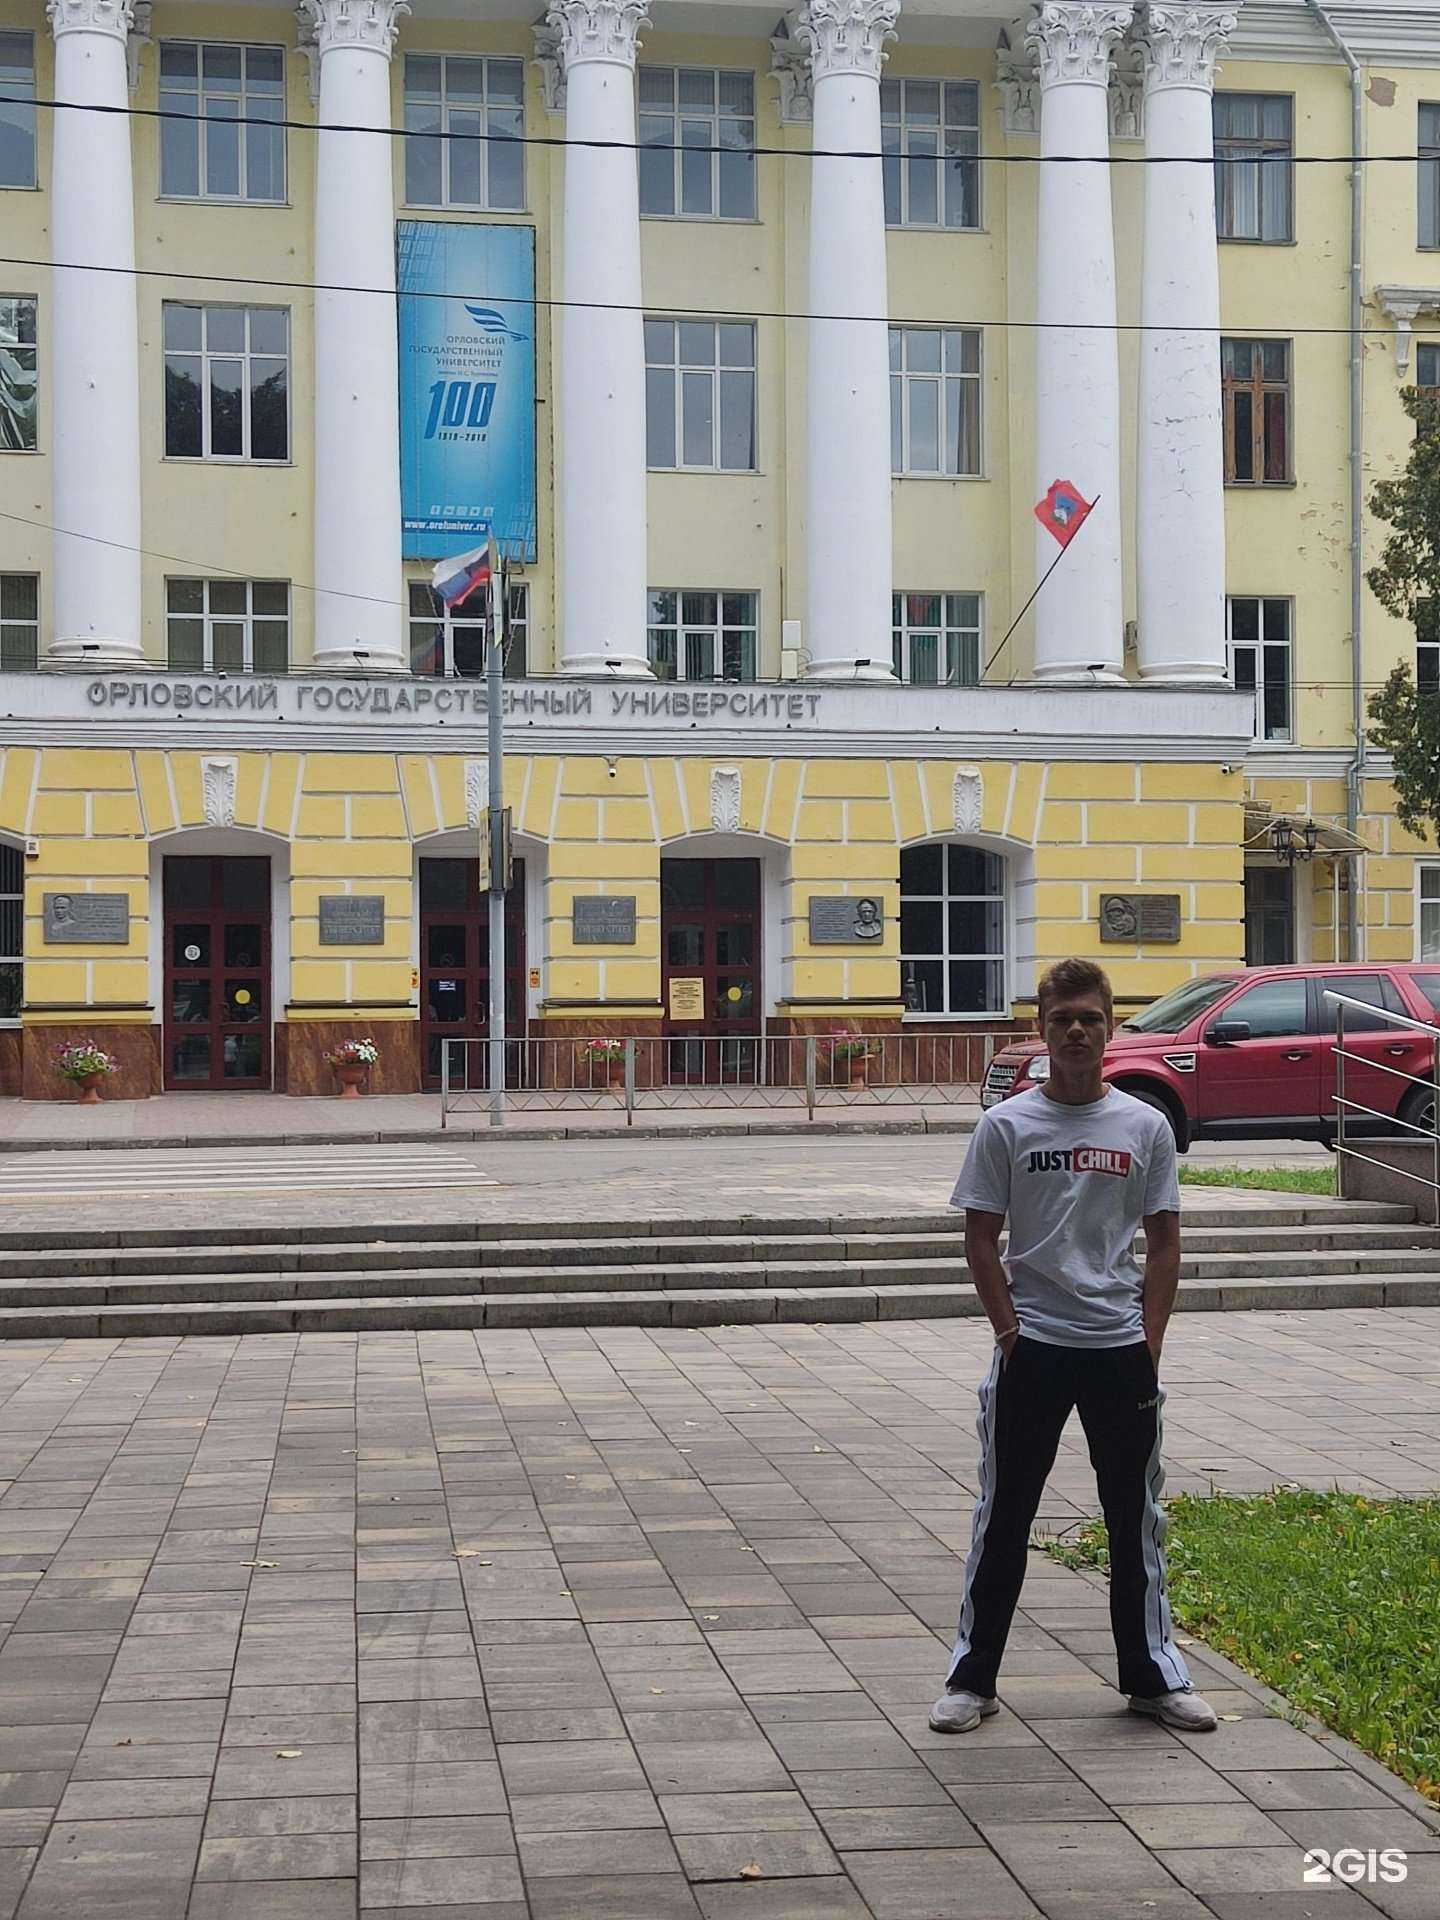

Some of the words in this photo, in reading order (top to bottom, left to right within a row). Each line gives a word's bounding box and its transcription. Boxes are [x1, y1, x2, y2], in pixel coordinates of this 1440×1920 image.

[446, 335, 505, 345] ОРЛОВСКИЙ
[435, 358, 502, 368] УНИВЕРСИТЕТ
[424, 380, 497, 439] 100
[86, 682, 277, 710] ОРЛОВСКИЙ
[611, 690, 821, 718] УНИВЕРСИТЕТ
[1027, 1150, 1073, 1173] JUST
[1077, 1150, 1127, 1175] CHILL.
